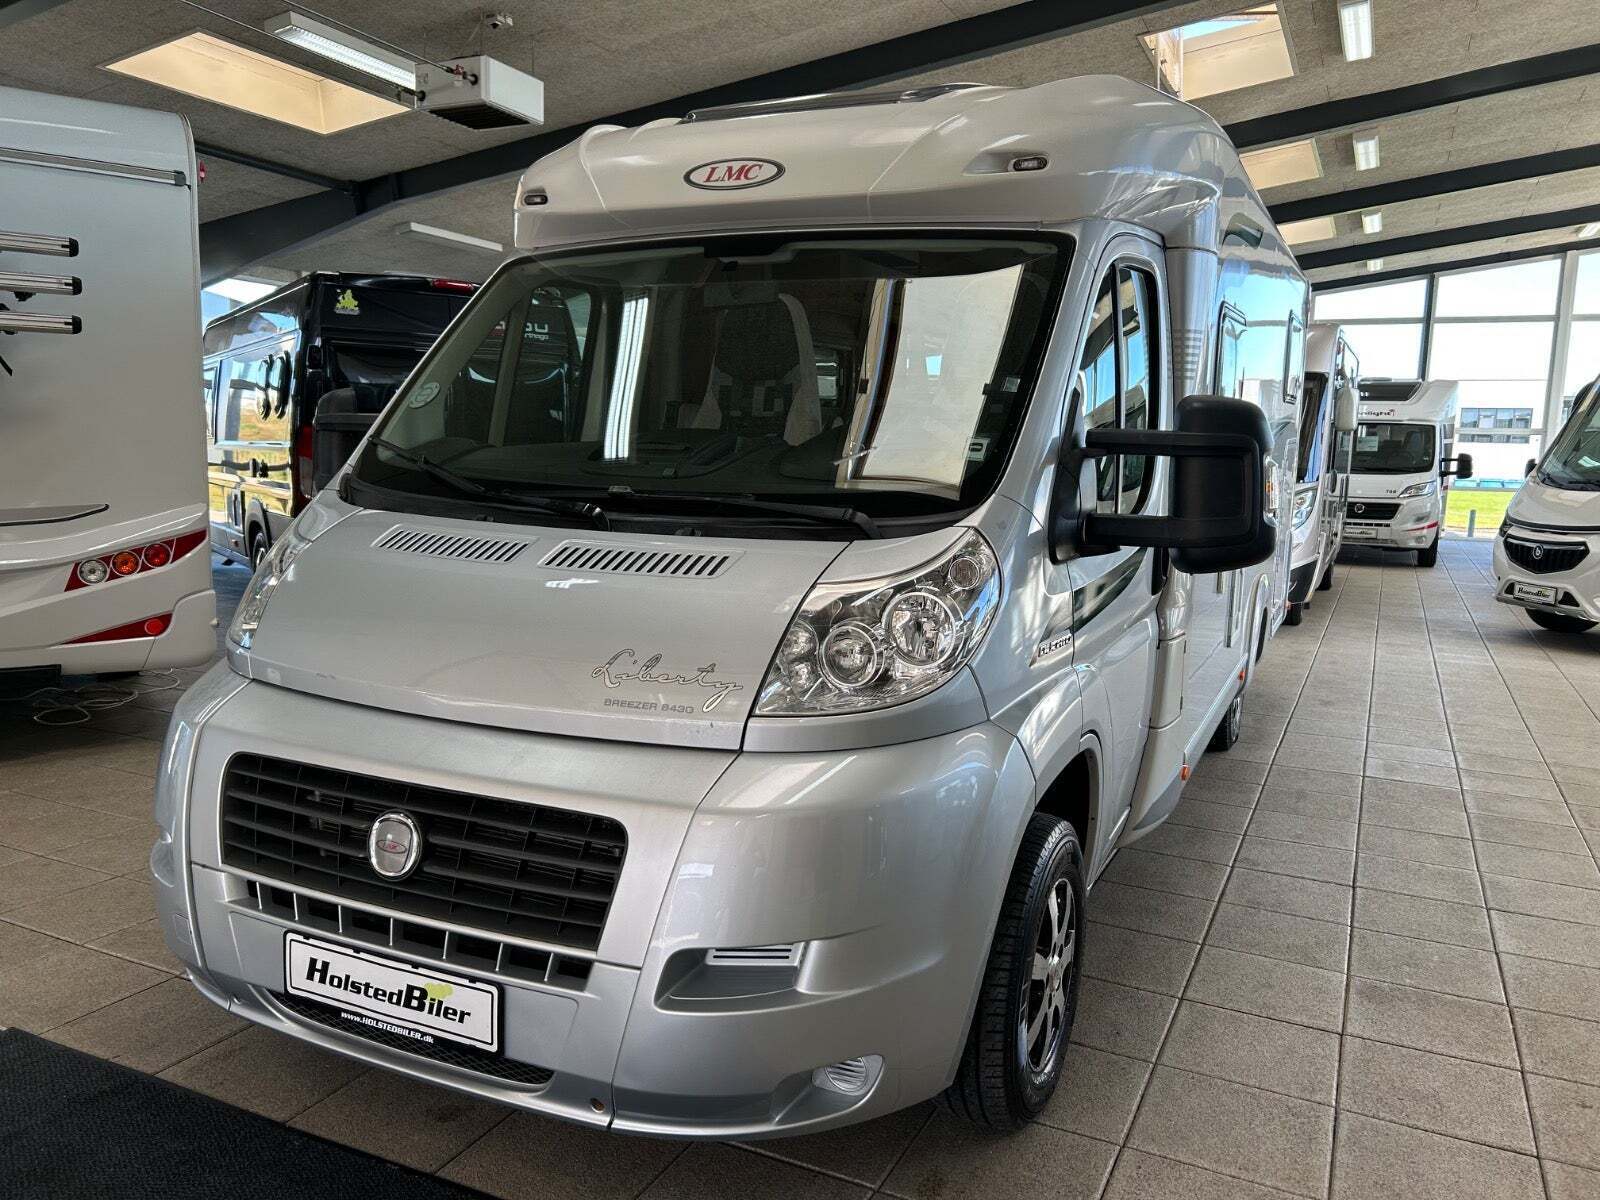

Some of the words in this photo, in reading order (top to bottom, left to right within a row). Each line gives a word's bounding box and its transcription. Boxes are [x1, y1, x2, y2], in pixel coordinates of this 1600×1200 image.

[703, 163, 764, 183] LMC
[591, 648, 743, 713] Liberty
[604, 698, 657, 711] BREEZER
[306, 957, 471, 1024] HolstedBiler
